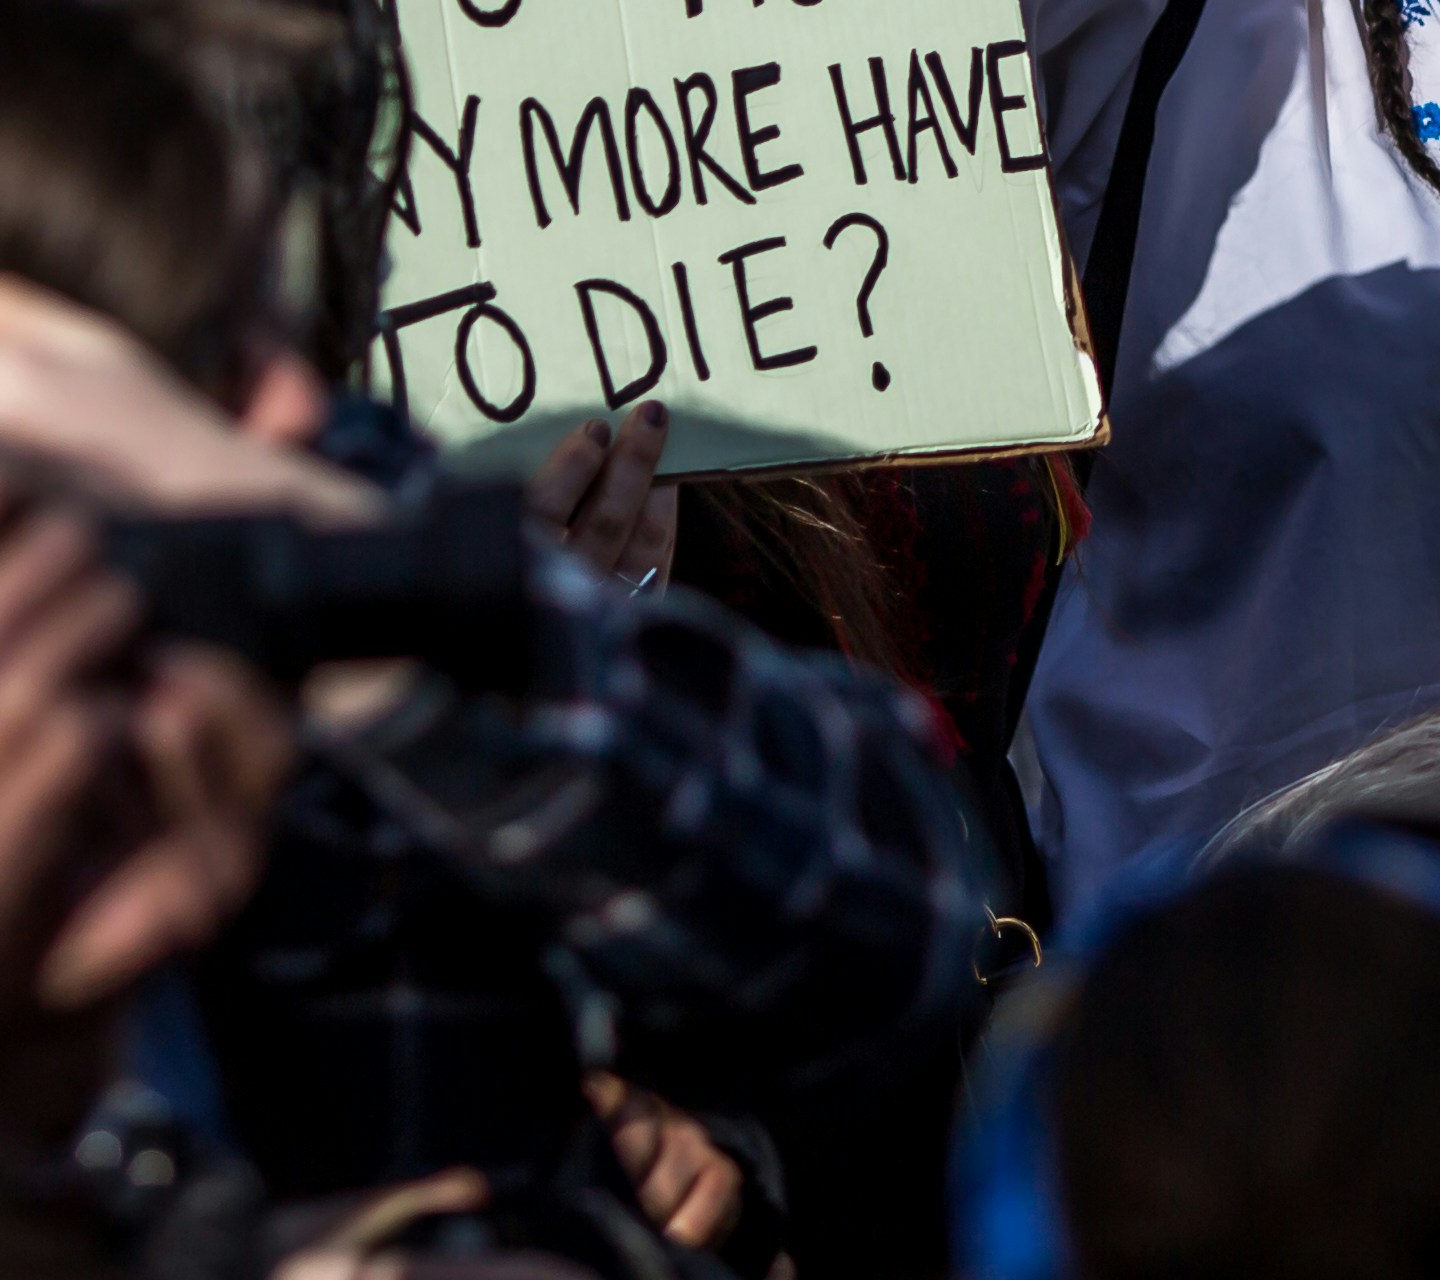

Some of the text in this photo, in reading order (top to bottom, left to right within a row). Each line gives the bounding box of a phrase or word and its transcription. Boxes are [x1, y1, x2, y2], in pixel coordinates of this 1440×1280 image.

[520, 62, 804, 229] MORE
[827, 39, 1049, 185] HAVE
[377, 212, 892, 425] TO DIE?
